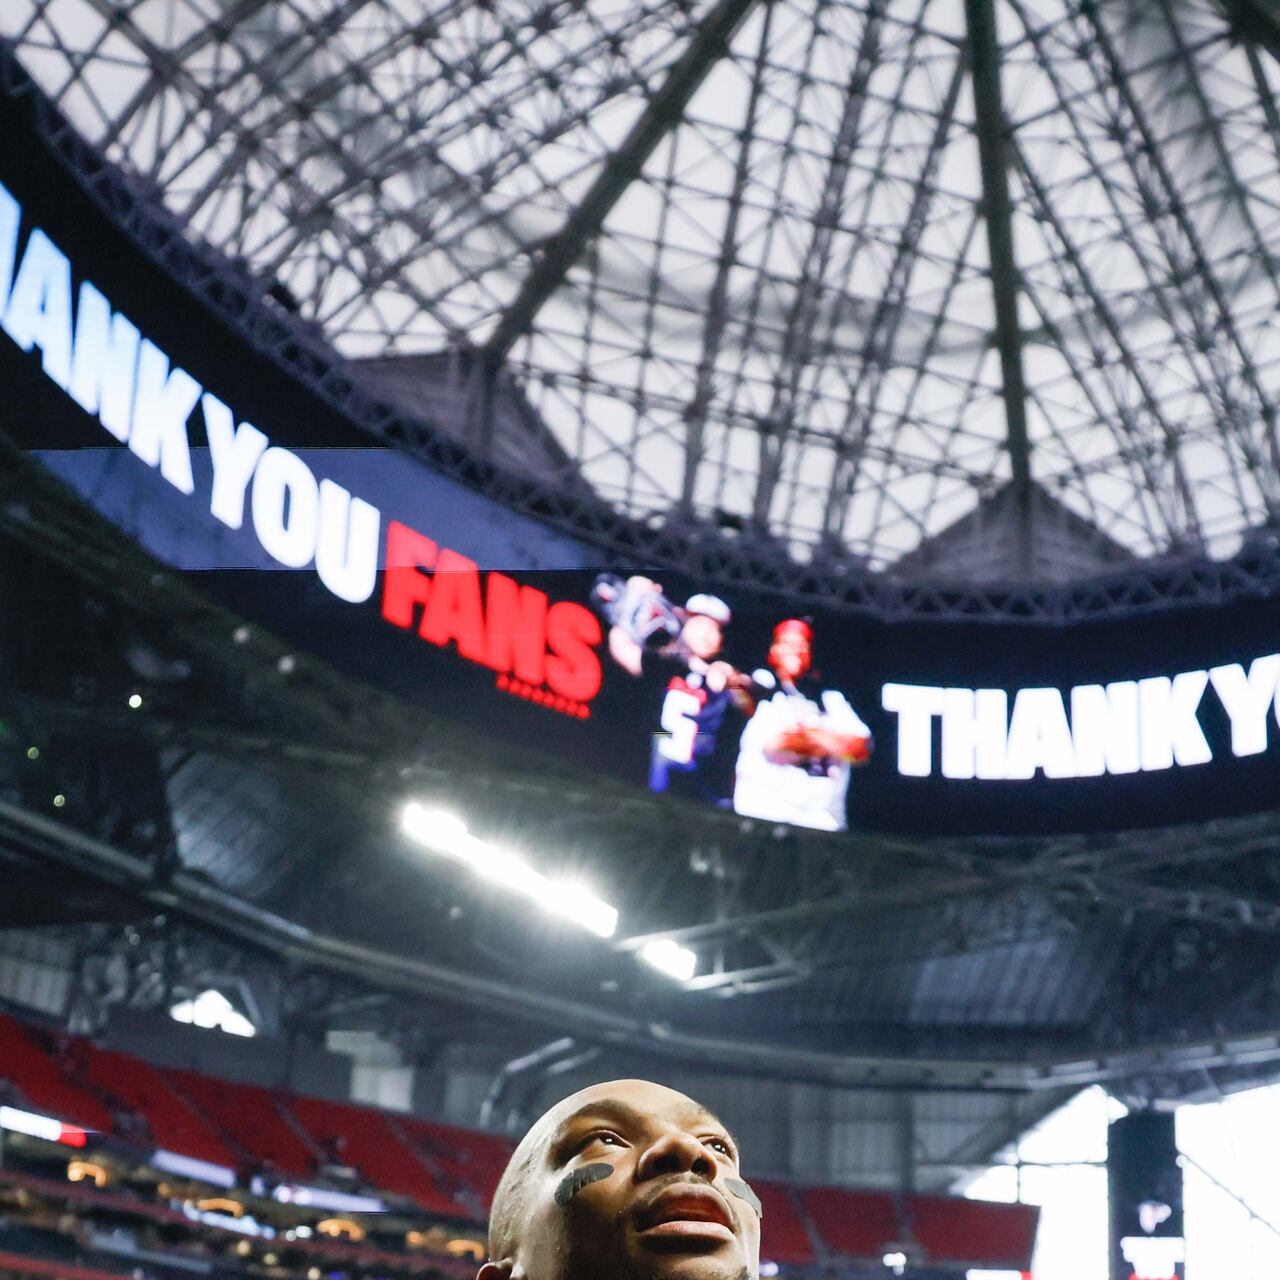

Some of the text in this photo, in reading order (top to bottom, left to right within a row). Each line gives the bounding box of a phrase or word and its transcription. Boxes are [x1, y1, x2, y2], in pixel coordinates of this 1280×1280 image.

[202, 390, 382, 604] YOU
[381, 520, 603, 704] FANS
[881, 669, 1213, 780] THANK
